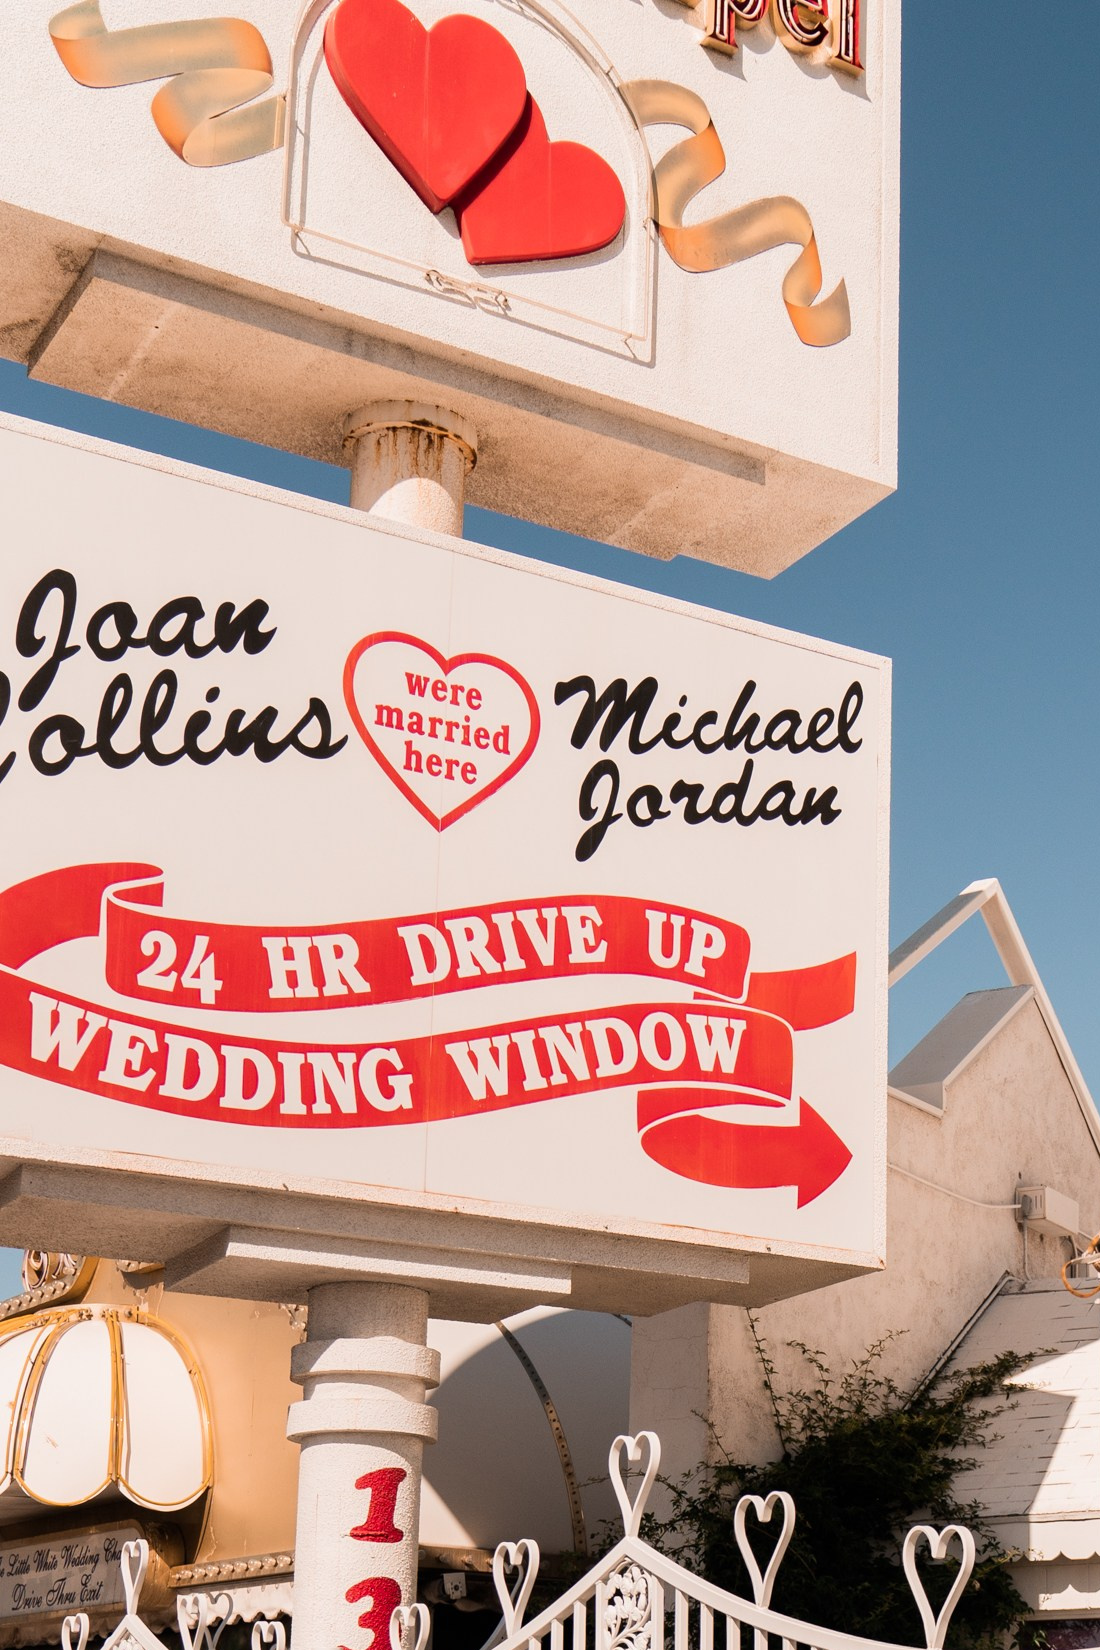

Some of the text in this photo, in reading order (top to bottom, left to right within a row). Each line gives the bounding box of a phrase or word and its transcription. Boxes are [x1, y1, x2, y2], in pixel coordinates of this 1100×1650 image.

[16, 568, 278, 712] Joan
[0, 668, 349, 784] ollins
[373, 703, 511, 756] married
[404, 671, 483, 711] were
[554, 675, 864, 755] Michael
[402, 739, 478, 785] here
[575, 758, 842, 863] Jordan
[136, 905, 727, 1005] 24 HR DRIVE UP
[28, 991, 747, 1115] WEDDING WINDOW
[7, 1553, 30, 1577] Little
[33, 1549, 58, 1574] White
[61, 1544, 100, 1573] Wedding
[12, 1574, 104, 1611] Drive Thru Exit
